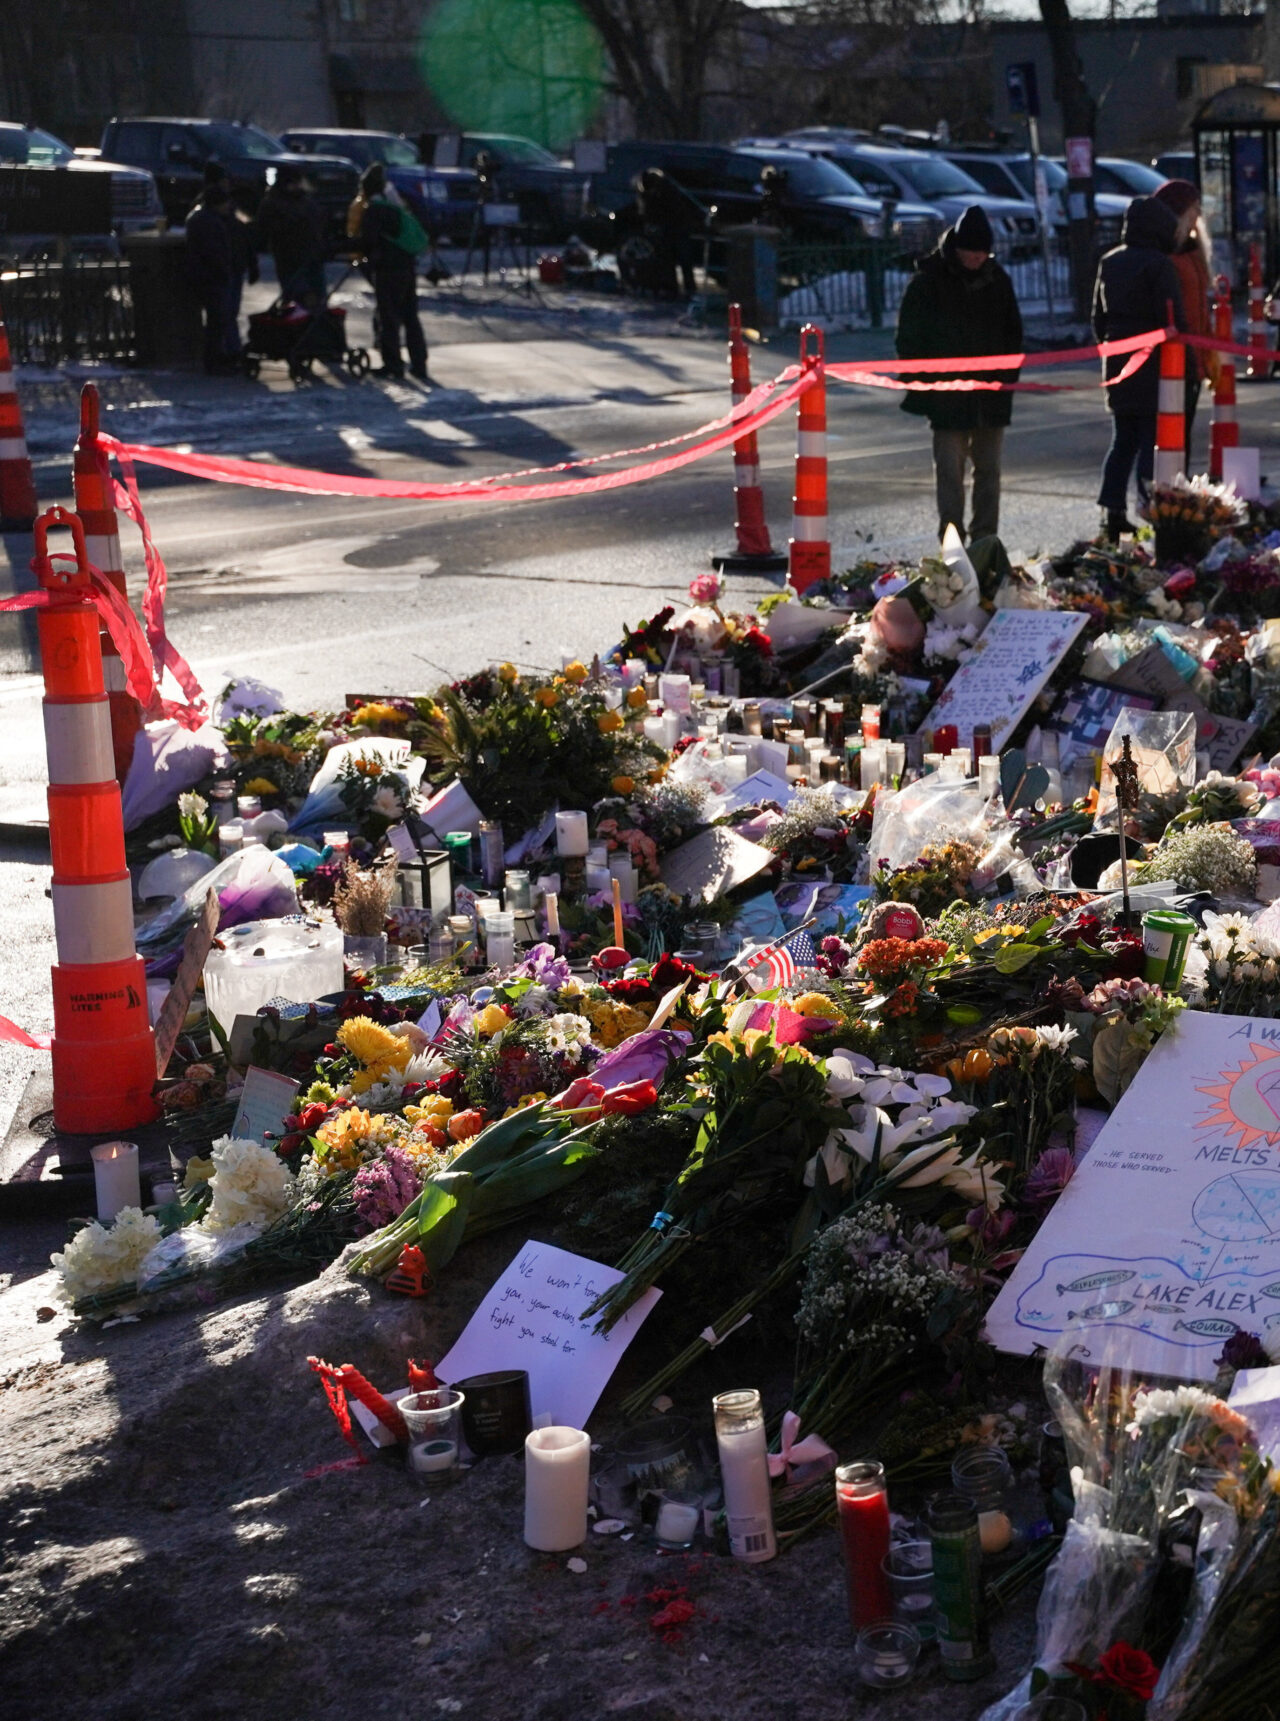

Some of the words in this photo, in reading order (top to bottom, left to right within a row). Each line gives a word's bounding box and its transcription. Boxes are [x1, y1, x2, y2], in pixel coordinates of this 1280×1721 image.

[893, 917, 913, 925] Bobbi
[70, 990, 125, 1002] WARNING
[71, 1003, 102, 1013] LITES
[1227, 1021, 1253, 1039] A
[1128, 1151, 1164, 1161] SERVED
[1194, 1144, 1271, 1165] MELTS
[1092, 1159, 1119, 1169] THOSE
[1121, 1162, 1140, 1171] WHO
[519, 1253, 539, 1278] We
[546, 1273, 582, 1289] won't
[1132, 1283, 1196, 1304] LAKE
[1198, 1288, 1263, 1314] ALEX
[500, 1286, 525, 1303] you,
[527, 1297, 550, 1312] your
[580, 1322, 591, 1330] or
[490, 1307, 515, 1329] fight
[517, 1326, 535, 1339] you
[540, 1332, 560, 1347] stood
